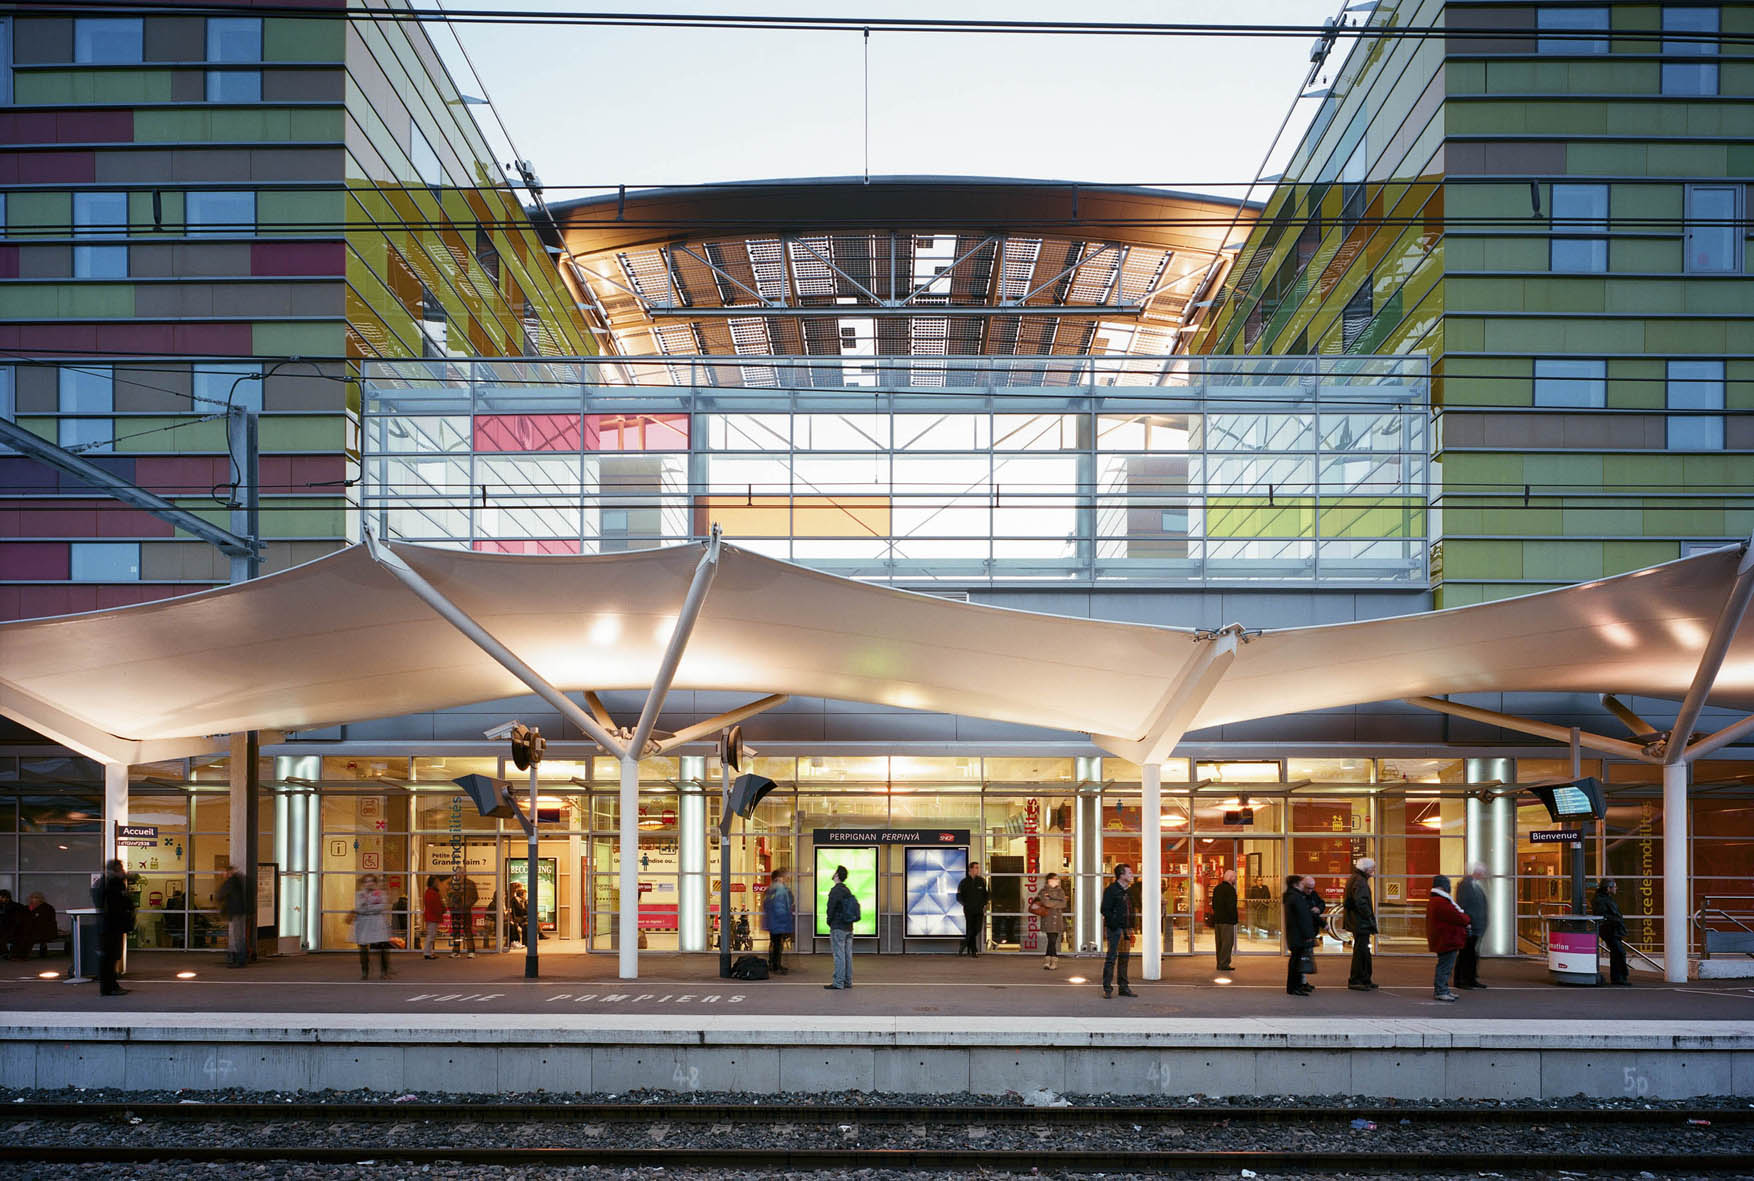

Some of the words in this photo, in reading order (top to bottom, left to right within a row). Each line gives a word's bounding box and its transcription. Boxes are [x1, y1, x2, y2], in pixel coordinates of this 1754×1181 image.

[122, 827, 154, 836] Accueil
[829, 833, 877, 841] PERPIGNAN
[881, 832, 920, 841] PERPINYÀ
[1024, 798, 1038, 865] mobilités
[1532, 832, 1578, 840] Bienvenue
[1024, 867, 1038, 892] des
[1640, 869, 1653, 895] des
[1640, 898, 1656, 952] Espace
[408, 994, 504, 1002] VOIE
[546, 994, 747, 1003] POMPIERS
[203, 1056, 232, 1080] 47
[672, 1063, 699, 1088] 48
[1624, 1067, 1648, 1095] 50
